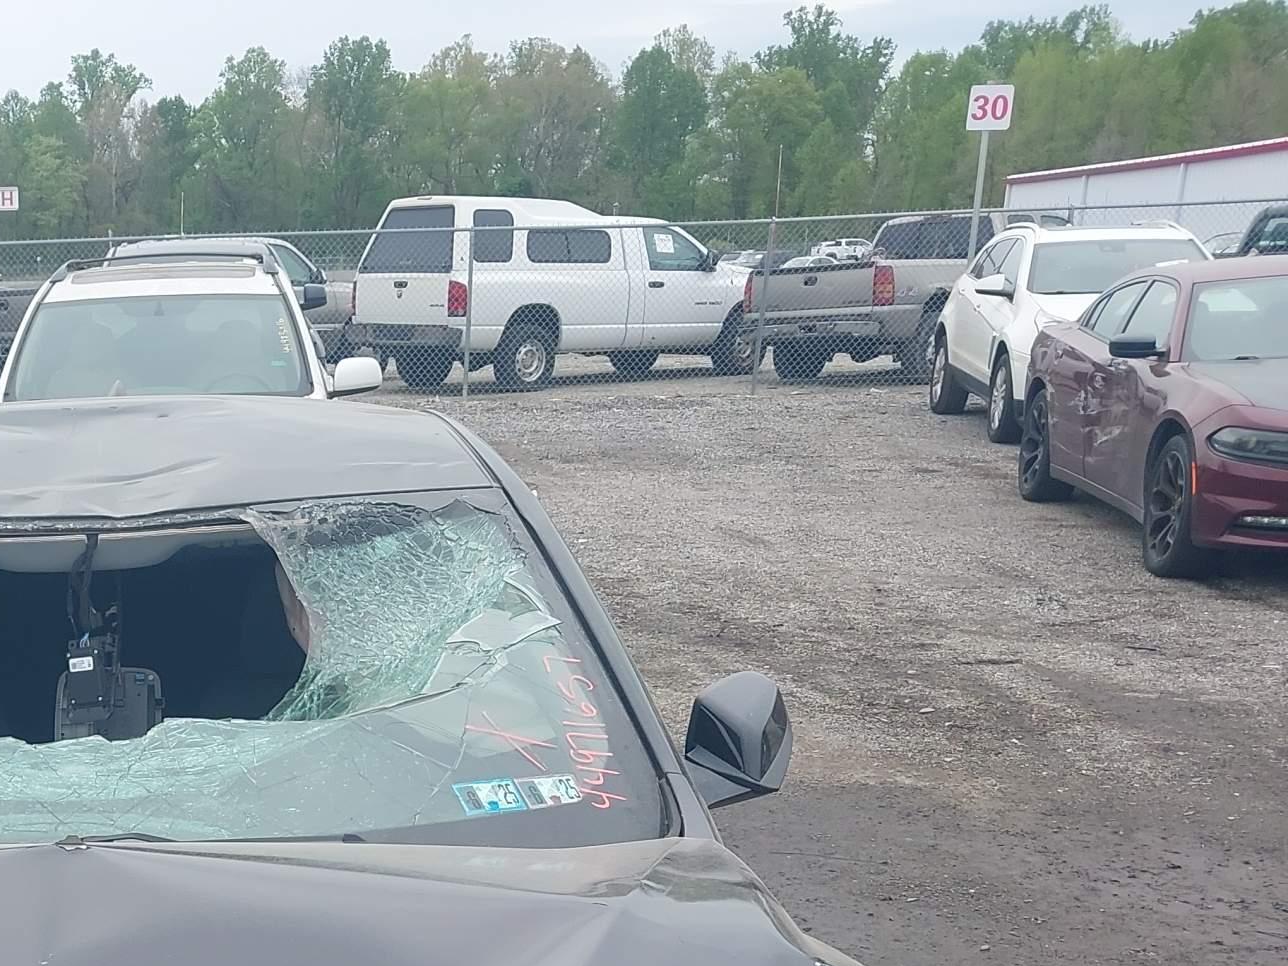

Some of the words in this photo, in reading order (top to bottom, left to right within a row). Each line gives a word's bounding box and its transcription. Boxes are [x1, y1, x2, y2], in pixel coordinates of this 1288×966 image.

[971, 94, 1009, 121] 30
[2, 192, 13, 207] H
[543, 654, 628, 810] 44971657
[497, 783, 520, 805] 25
[558, 778, 581, 800] 25
